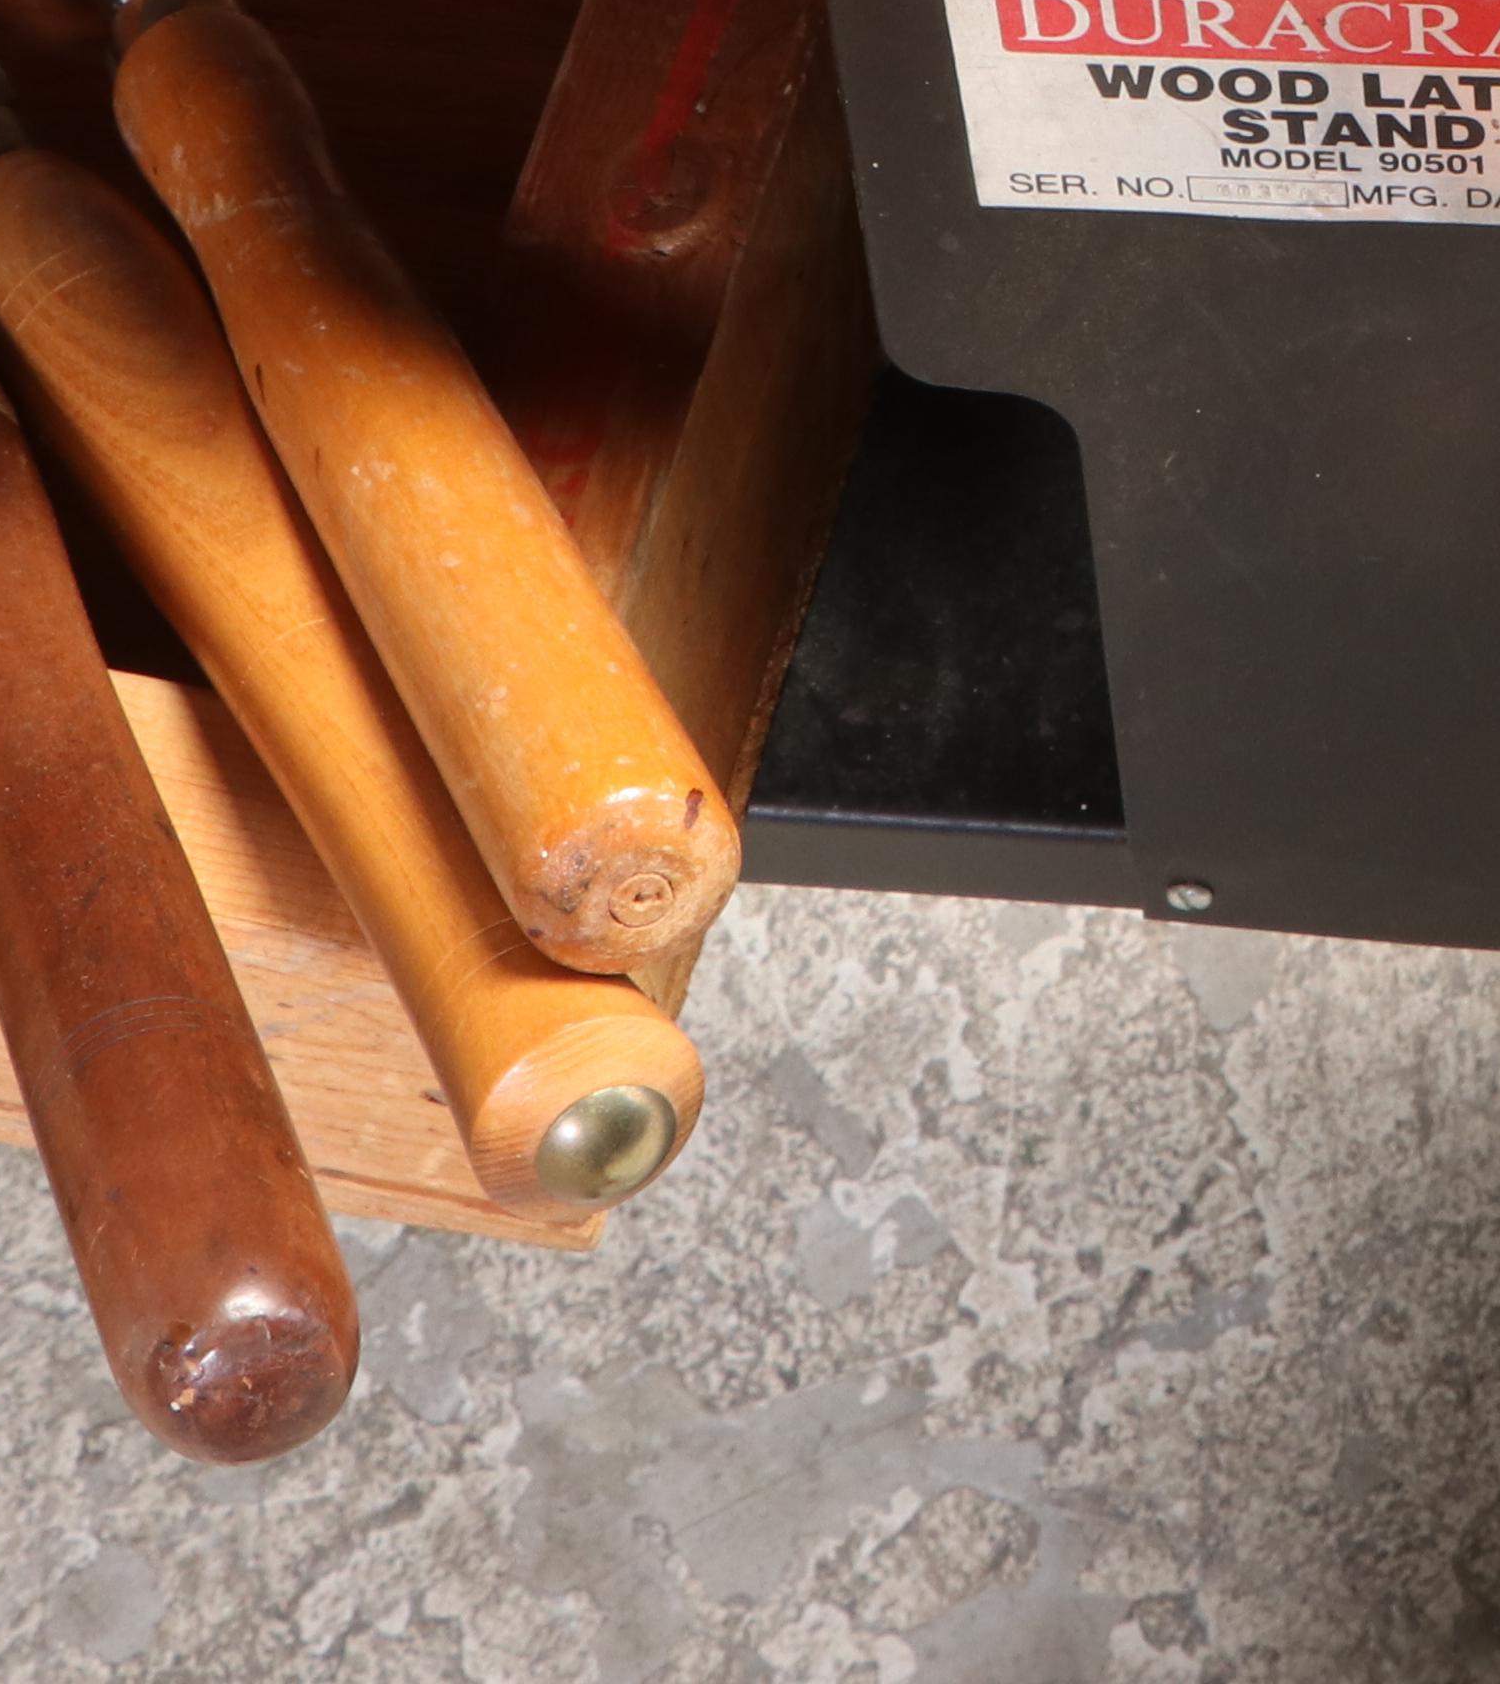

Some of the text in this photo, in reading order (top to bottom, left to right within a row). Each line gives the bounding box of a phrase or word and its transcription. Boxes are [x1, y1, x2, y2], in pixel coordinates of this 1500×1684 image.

[1087, 63, 1330, 107] WOOD
[1222, 108, 1486, 150] STAND
[1220, 147, 1485, 176] MODEL 90501
[1008, 172, 1185, 199] SER. NO.
[1353, 184, 1449, 209] MFG.
